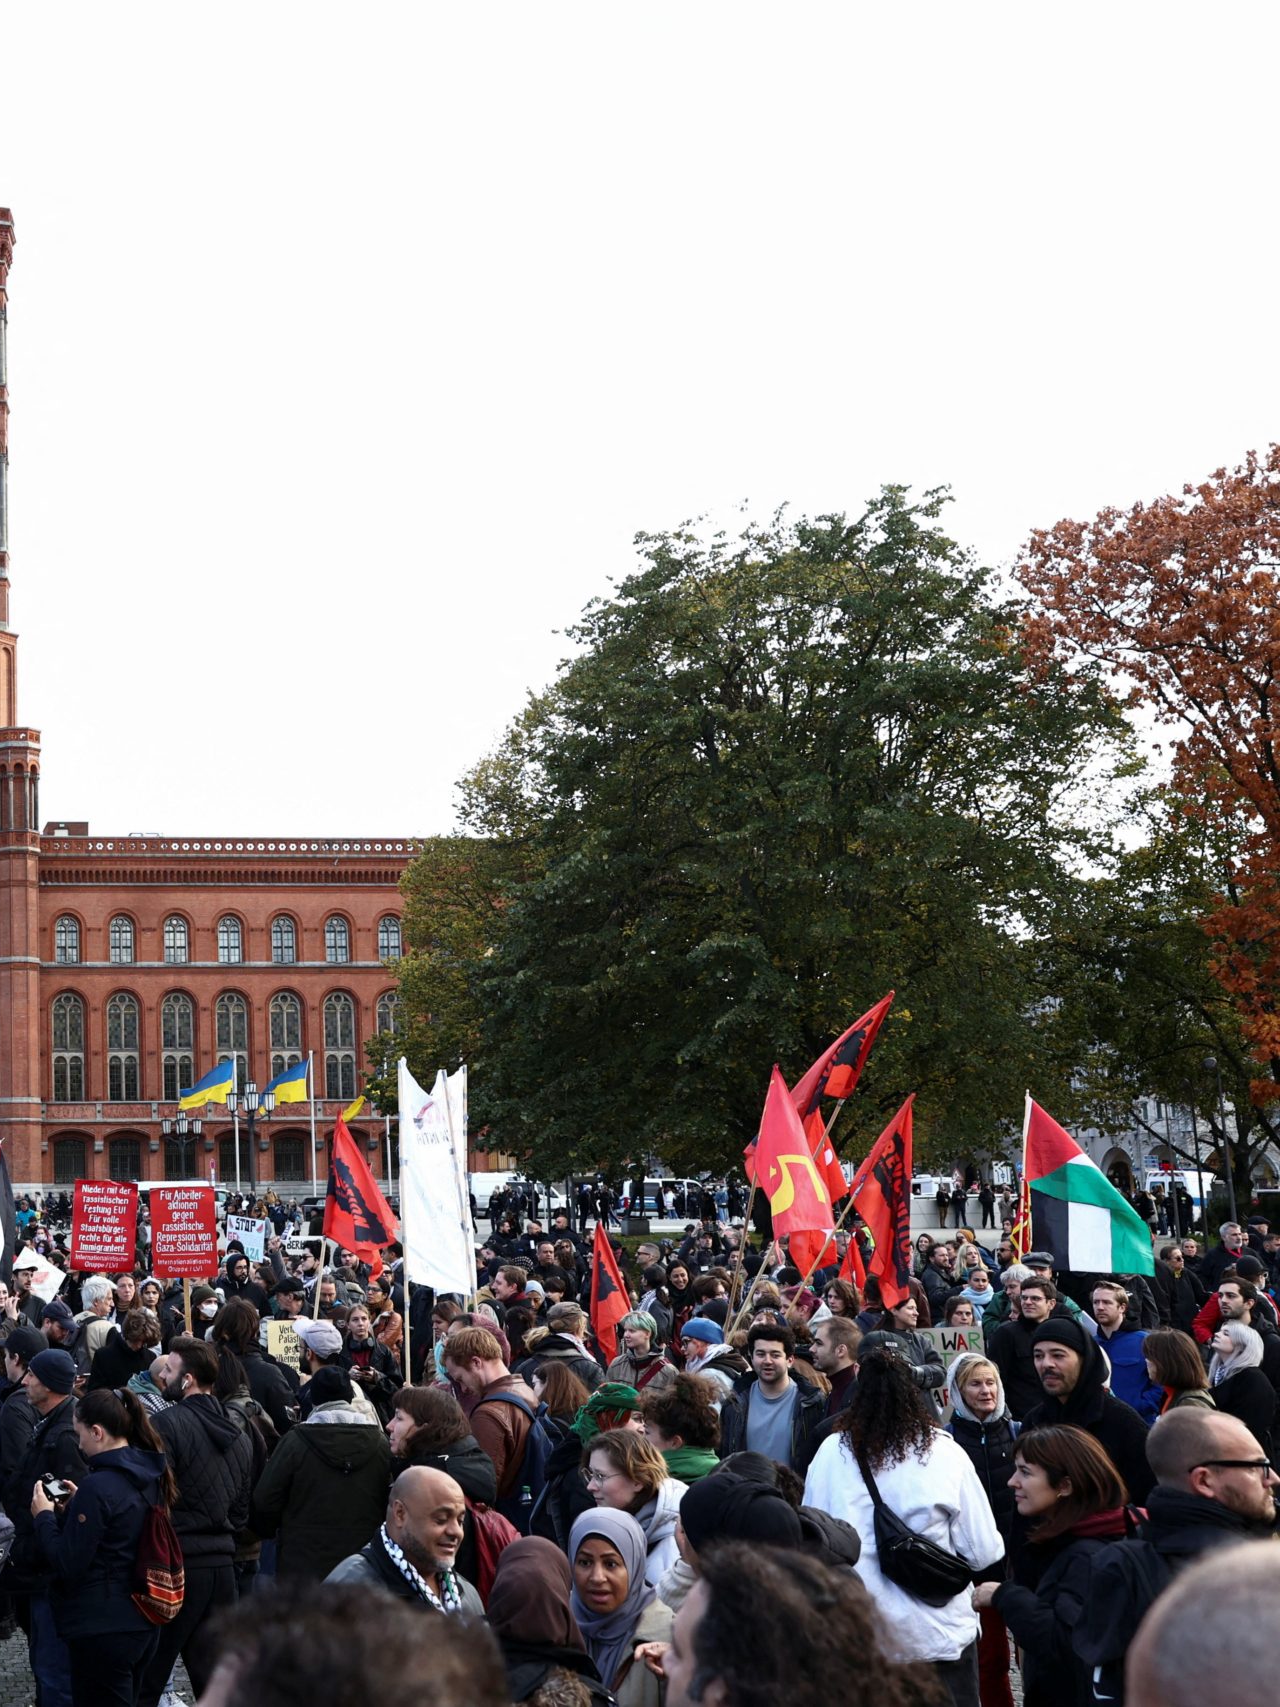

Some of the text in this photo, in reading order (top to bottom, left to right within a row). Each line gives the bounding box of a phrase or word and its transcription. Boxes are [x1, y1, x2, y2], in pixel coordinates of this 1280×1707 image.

[82, 1184, 132, 1194] Nieder mit der
[82, 1195, 129, 1204] rassistischen
[160, 1190, 206, 1200] Für Arbeiter-
[84, 1204, 112, 1215] Festung
[168, 1200, 198, 1210] aktionen
[88, 1214, 120, 1224] Für volle
[172, 1211, 194, 1222] gegen
[80, 1224, 128, 1234] Staatsbürger-
[162, 1220, 204, 1232] rassistische
[235, 1218, 256, 1232] STOP
[78, 1233, 128, 1242] rechte für alle
[156, 1232, 212, 1243] Repression von
[156, 1242, 213, 1252] Gaza-Solidarität
[941, 1332, 982, 1351] WAR
